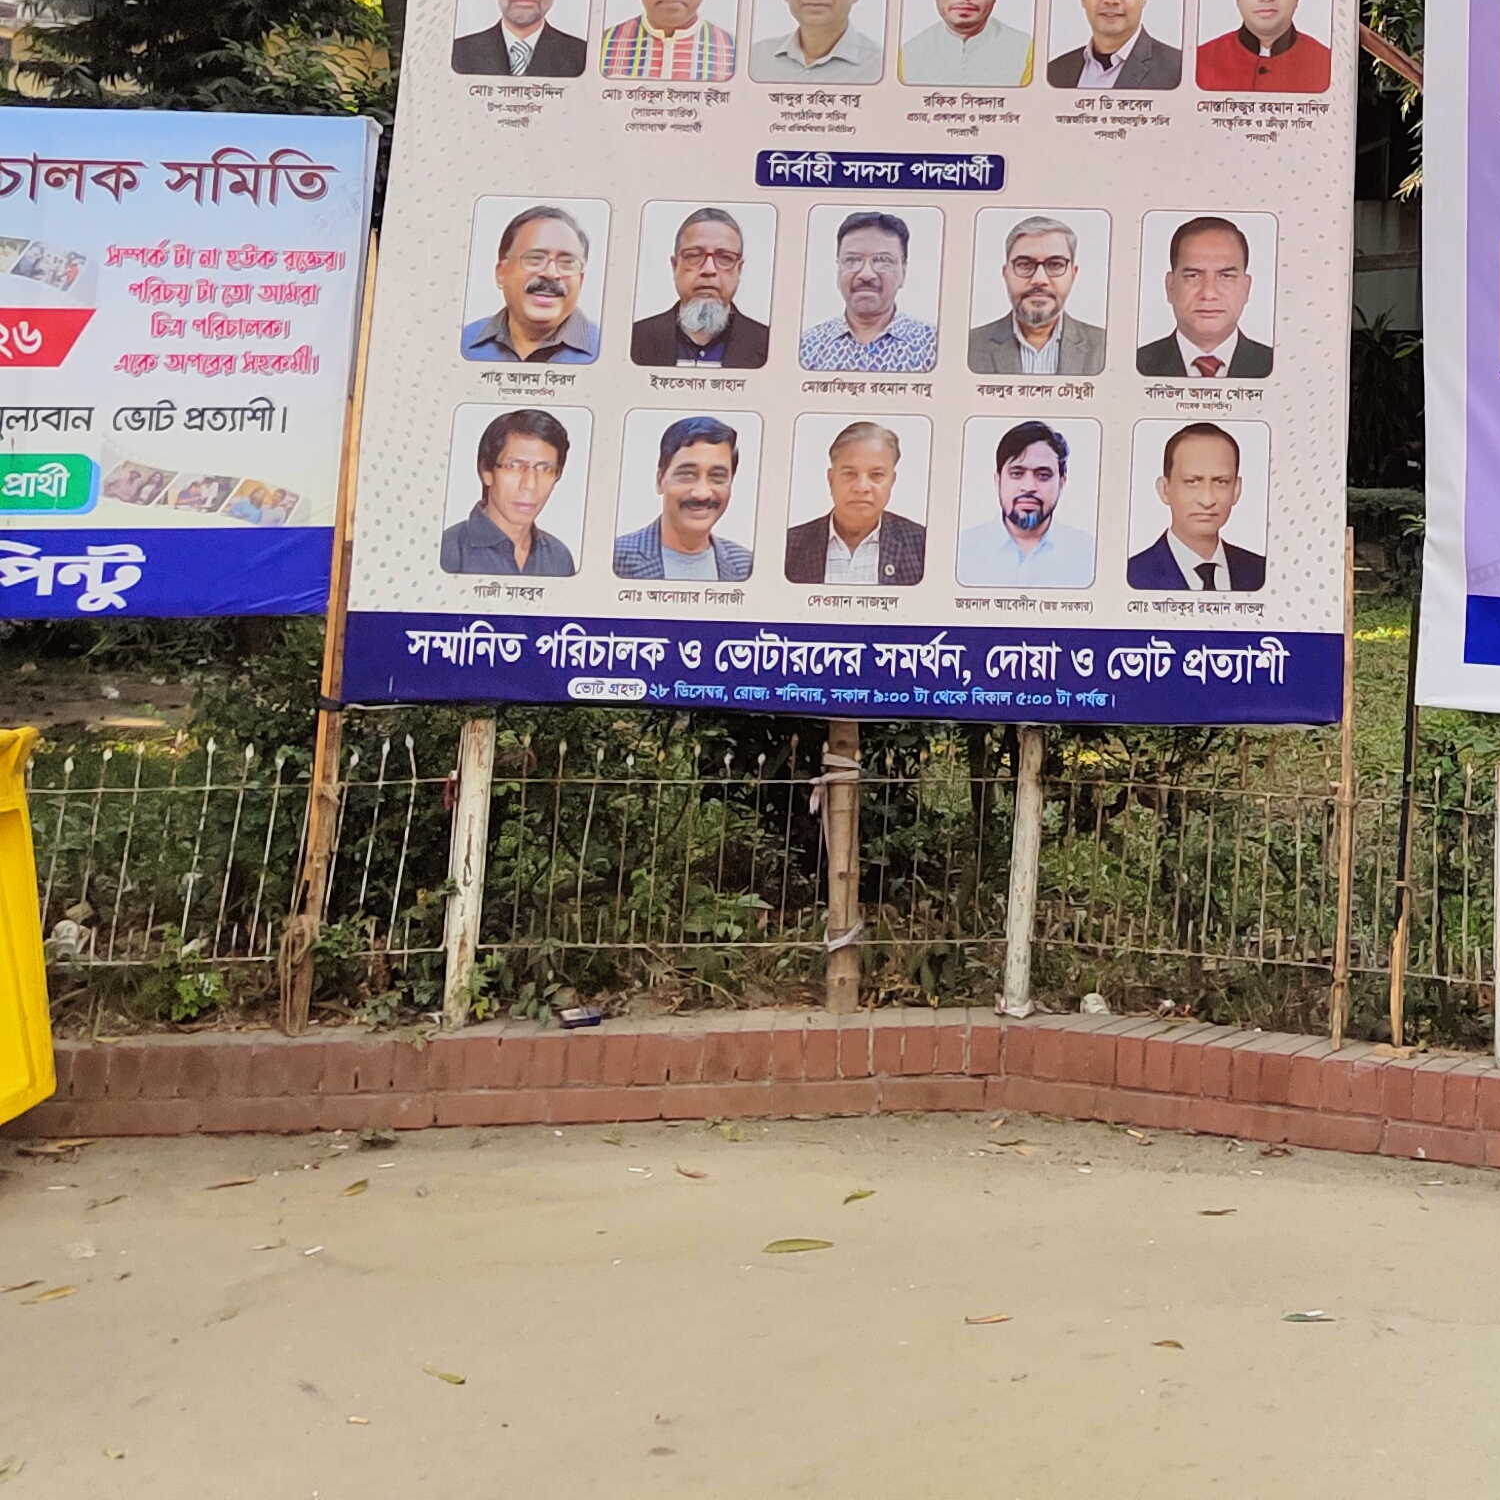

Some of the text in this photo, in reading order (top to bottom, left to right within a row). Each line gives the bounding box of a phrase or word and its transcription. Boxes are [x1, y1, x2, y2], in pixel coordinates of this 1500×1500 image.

[160, 146, 340, 206] সমিতি
[766, 152, 994, 186] নির্বাহী সদস্য পদপ্রার্থী
[104, 238, 170, 269] সম্পর্ক
[173, 246, 192, 269] টা
[199, 248, 219, 269] না
[128, 276, 320, 306] পরিচয় টা তো আমরা
[150, 311, 184, 339] চিত্র
[112, 351, 158, 373] একে
[163, 352, 236, 378] অপরের
[405, 619, 1291, 687] সম্মানিত পরিচালক ও ভোটারদের সমর্থন, দোয়া ও ভোট প্রত্যাশী
